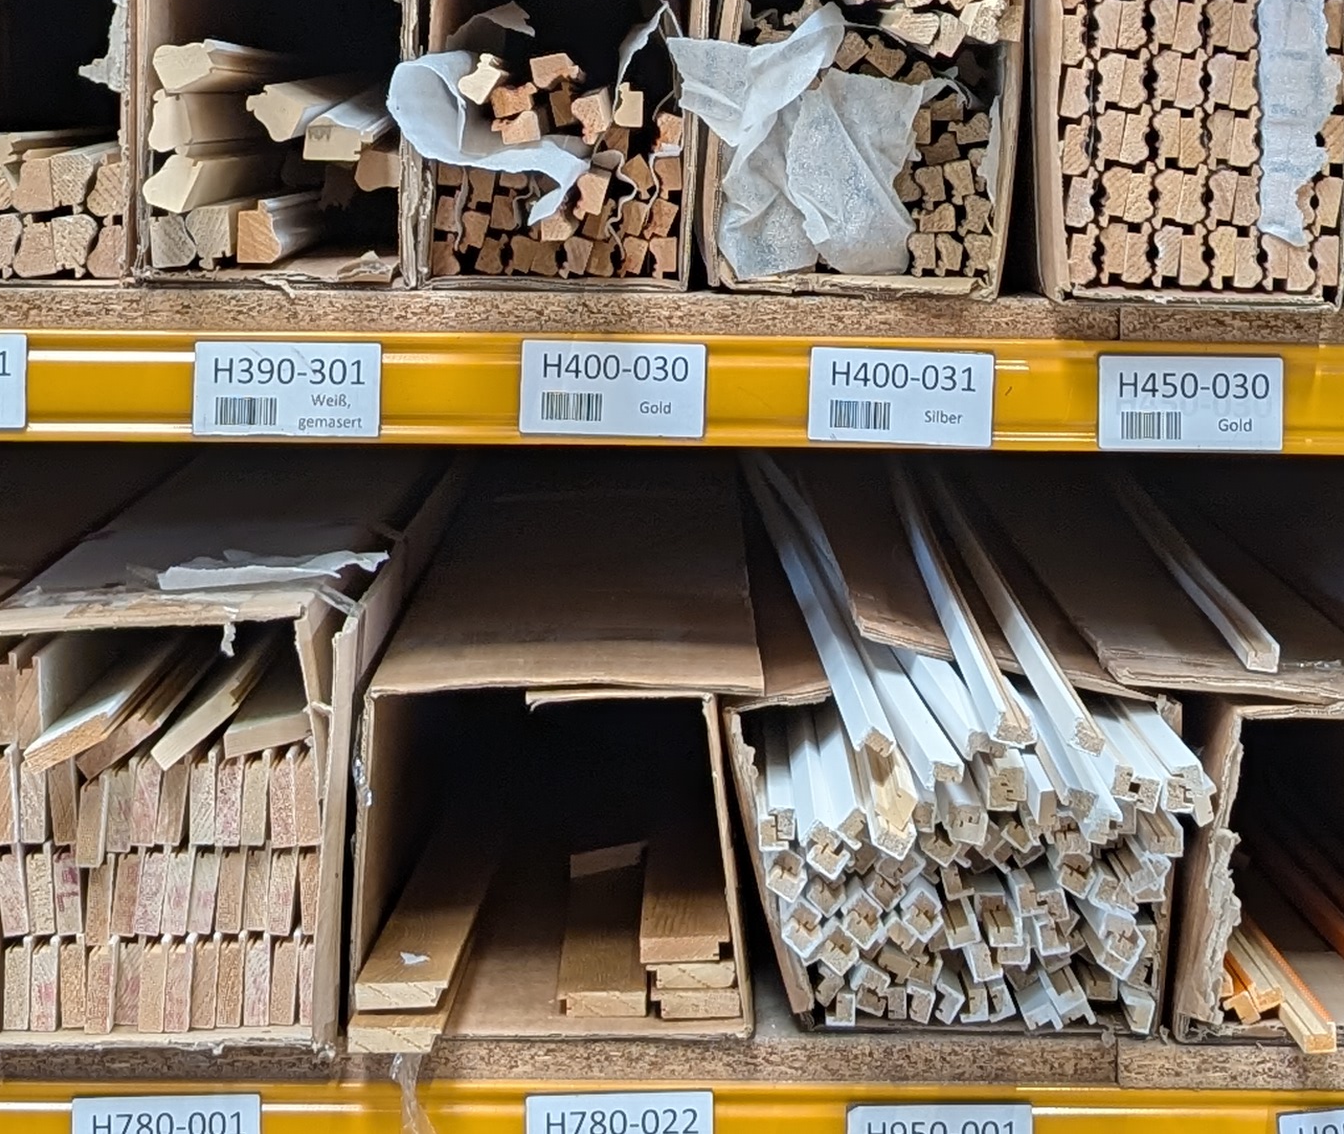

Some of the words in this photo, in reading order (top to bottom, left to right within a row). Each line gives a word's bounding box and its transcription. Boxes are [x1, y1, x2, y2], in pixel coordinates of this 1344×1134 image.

[213, 357, 366, 386] H390-301
[543, 353, 689, 382] H400-030
[831, 360, 976, 393] H400-031
[1119, 371, 1270, 400] H450-030
[310, 393, 351, 410] Weiß,
[639, 400, 672, 415] Gold
[297, 417, 363, 432] gemasert
[924, 409, 963, 425] Silber
[1218, 417, 1253, 433] Gold
[92, 1111, 241, 1134] H780-001
[546, 1108, 699, 1134] H780-022
